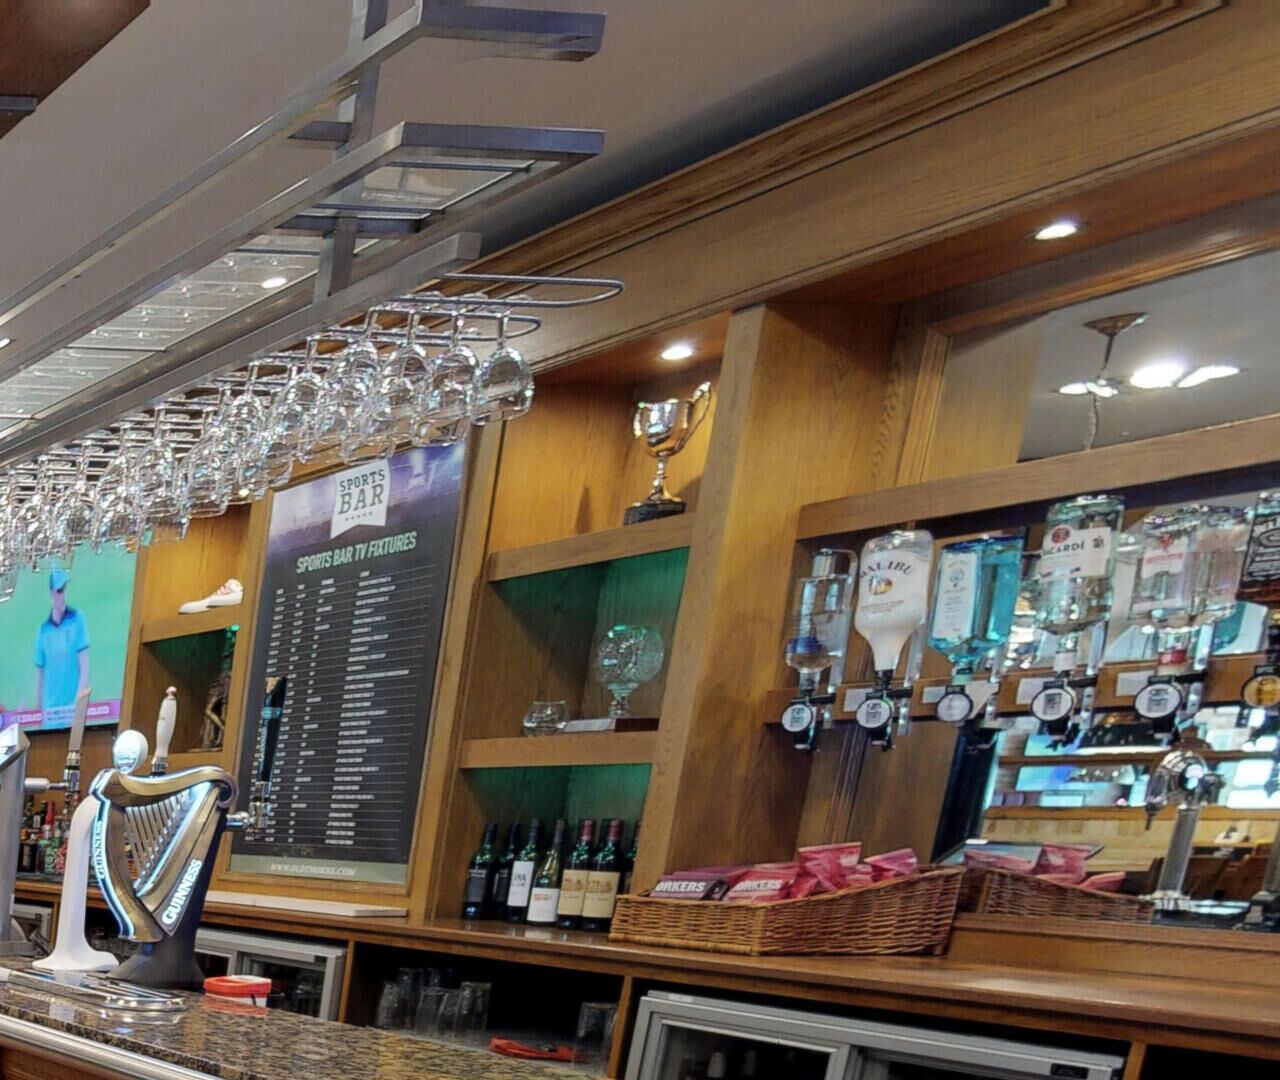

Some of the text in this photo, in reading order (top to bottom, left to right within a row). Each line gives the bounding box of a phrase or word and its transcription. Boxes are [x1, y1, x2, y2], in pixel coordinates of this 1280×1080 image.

[338, 484, 385, 515] BAR
[340, 469, 386, 493] SPORTS
[296, 531, 418, 574] SPORTS BAR TV FIXTURES
[94, 820, 106, 880] GUINNESS
[161, 858, 203, 925] GUINNESS
